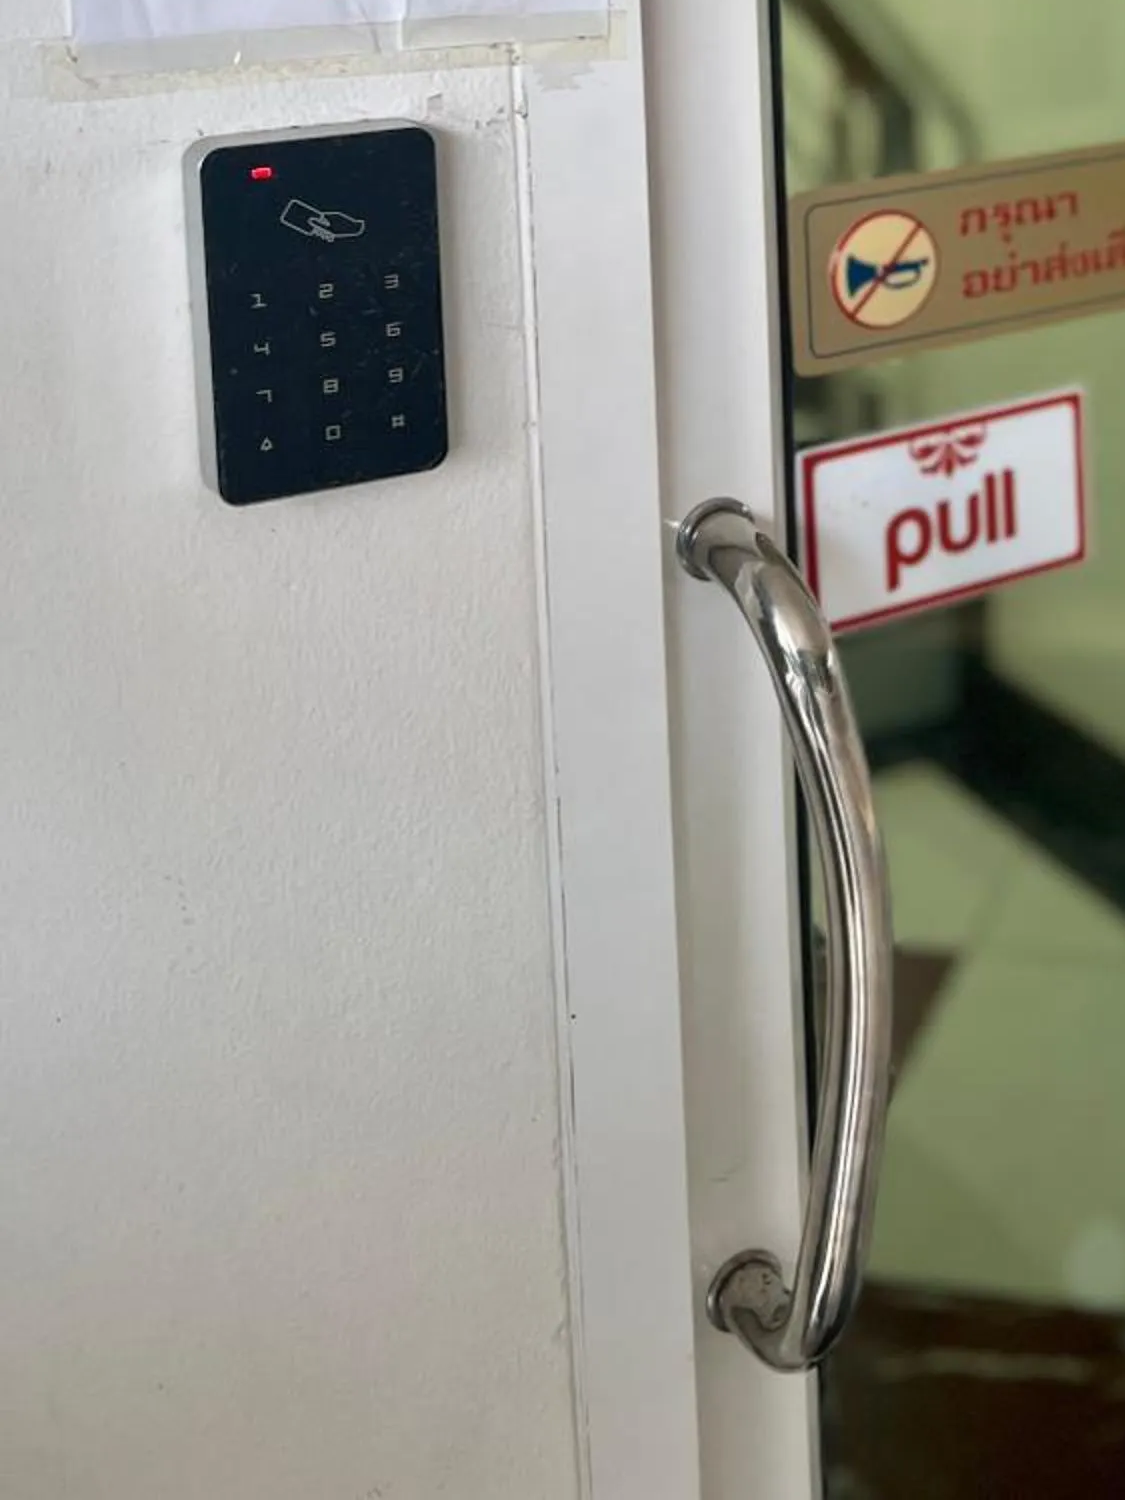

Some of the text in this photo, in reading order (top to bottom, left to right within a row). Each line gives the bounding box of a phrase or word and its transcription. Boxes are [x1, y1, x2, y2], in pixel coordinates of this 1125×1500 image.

[960, 191, 1079, 243] กรุณา
[251, 274, 398, 309] 1 2 3
[254, 322, 400, 357] 4 5 6
[255, 367, 403, 402] 7 8 9
[325, 425, 341, 441] 0
[885, 467, 1018, 591] pull
